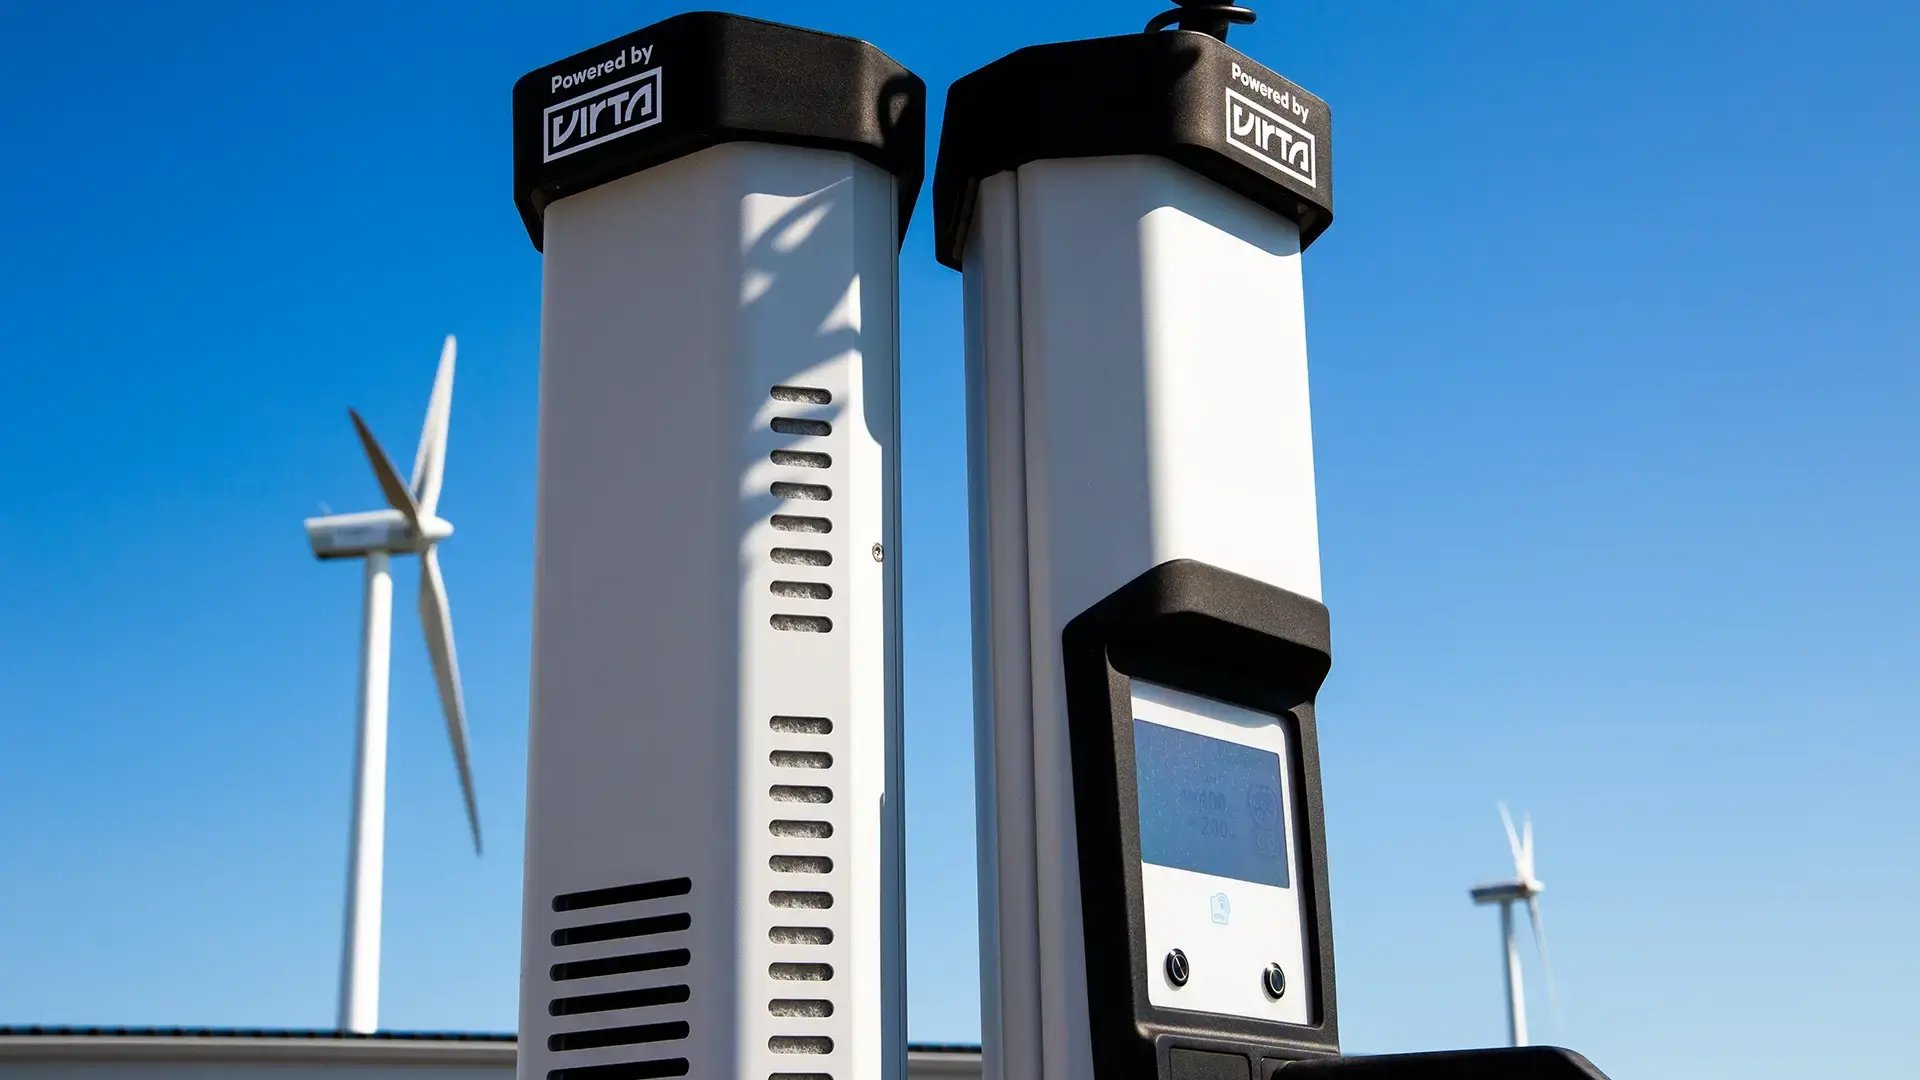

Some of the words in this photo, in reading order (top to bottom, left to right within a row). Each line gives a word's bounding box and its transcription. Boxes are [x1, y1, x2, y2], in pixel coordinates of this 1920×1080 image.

[551, 49, 626, 94] Powered
[631, 44, 654, 65] by
[1231, 61, 1290, 110] Powered
[1292, 95, 1310, 124] by
